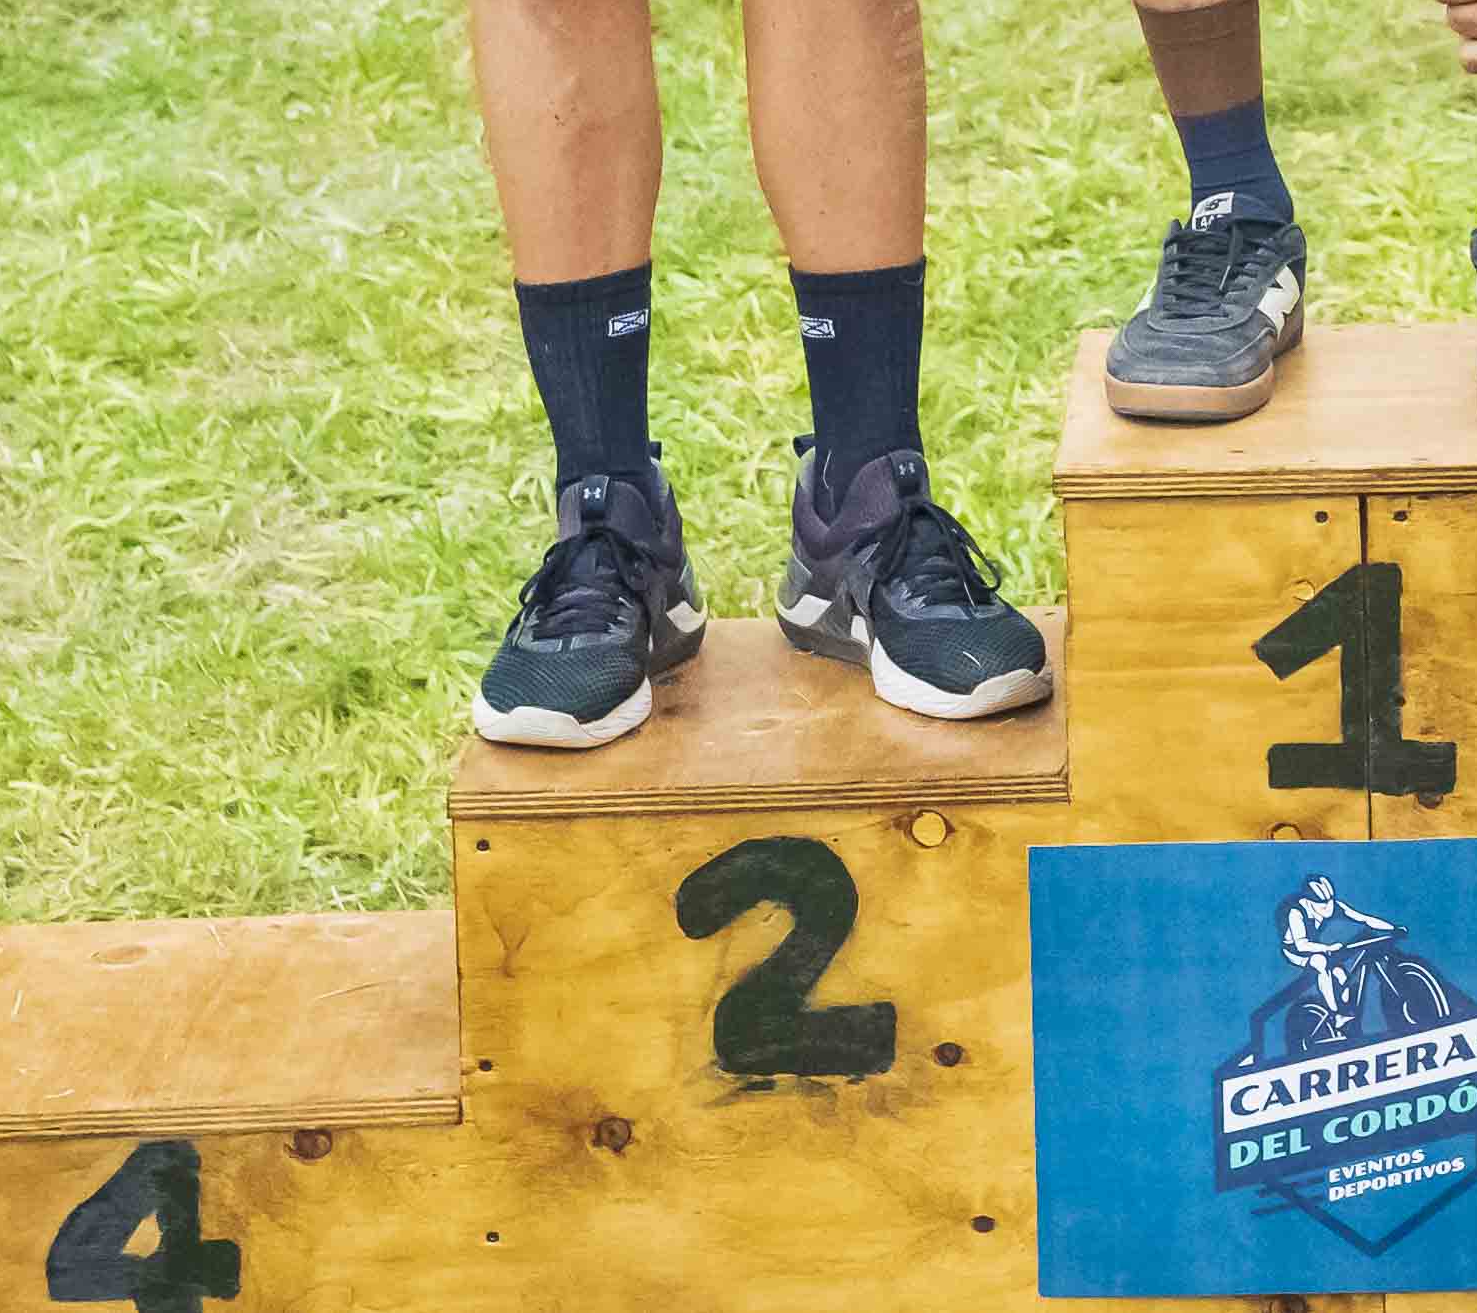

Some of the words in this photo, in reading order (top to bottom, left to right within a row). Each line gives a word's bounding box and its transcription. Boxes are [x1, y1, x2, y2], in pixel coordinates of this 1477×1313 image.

[1252, 562, 1459, 798] 1
[676, 835, 897, 1076] 2
[1229, 1128, 1311, 1169] DEL
[1328, 1149, 1425, 1183] EVENTOS
[1329, 1158, 1466, 1202] DEPORTIVOS
[47, 1140, 241, 1313] 4
